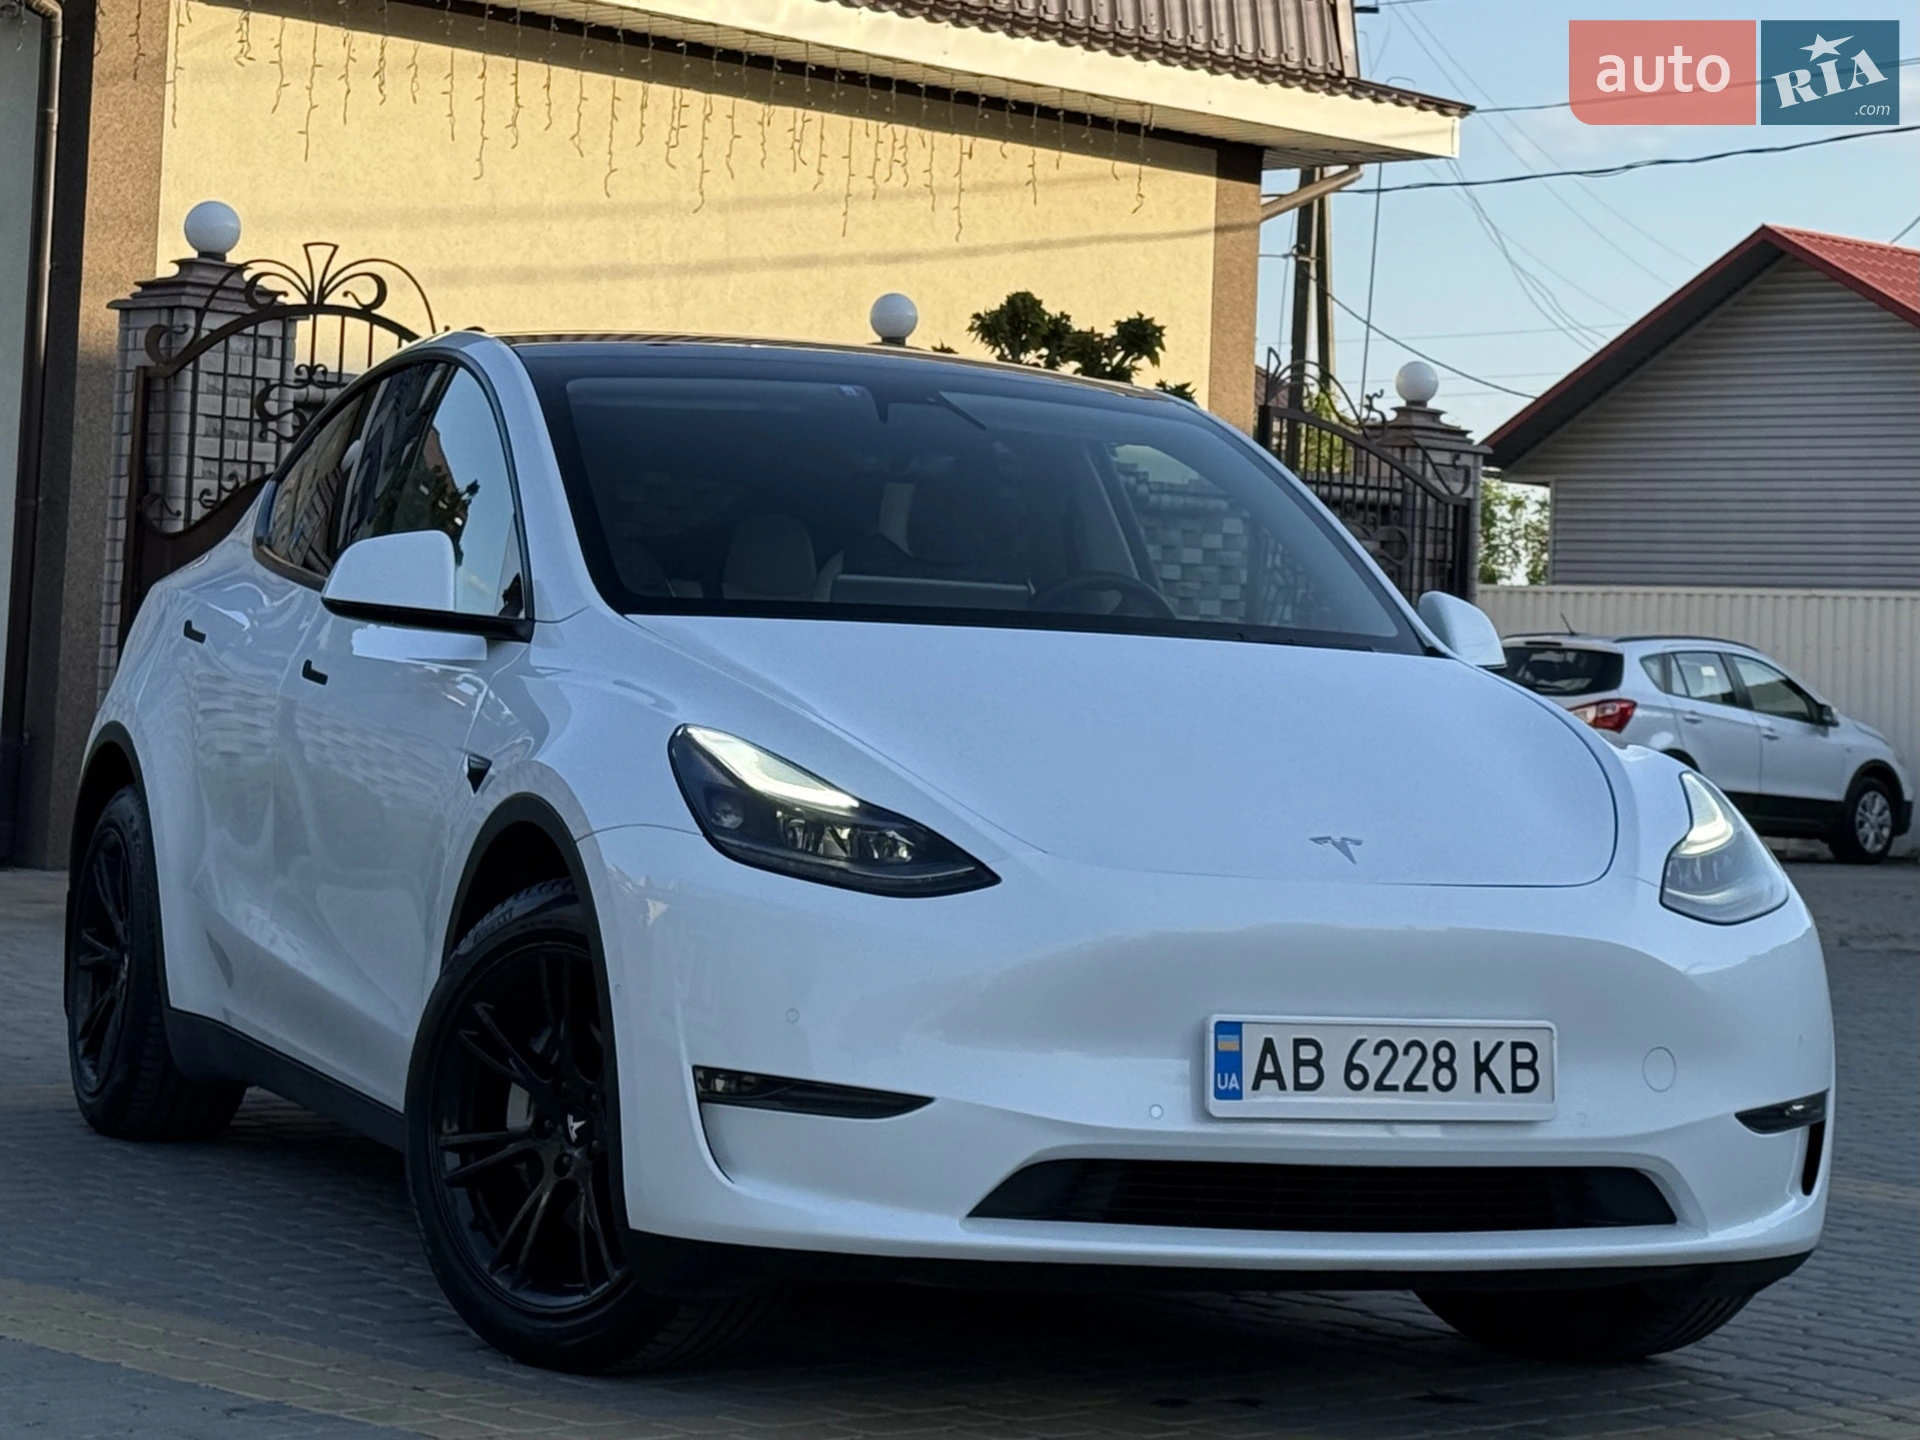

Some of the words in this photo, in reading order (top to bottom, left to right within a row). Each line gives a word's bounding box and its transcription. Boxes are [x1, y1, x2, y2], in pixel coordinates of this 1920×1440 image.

[1217, 1073, 1240, 1090] UA
[1251, 1037, 1325, 1092] AB
[1343, 1038, 1458, 1093] 6228
[1473, 1040, 1541, 1094] KB
